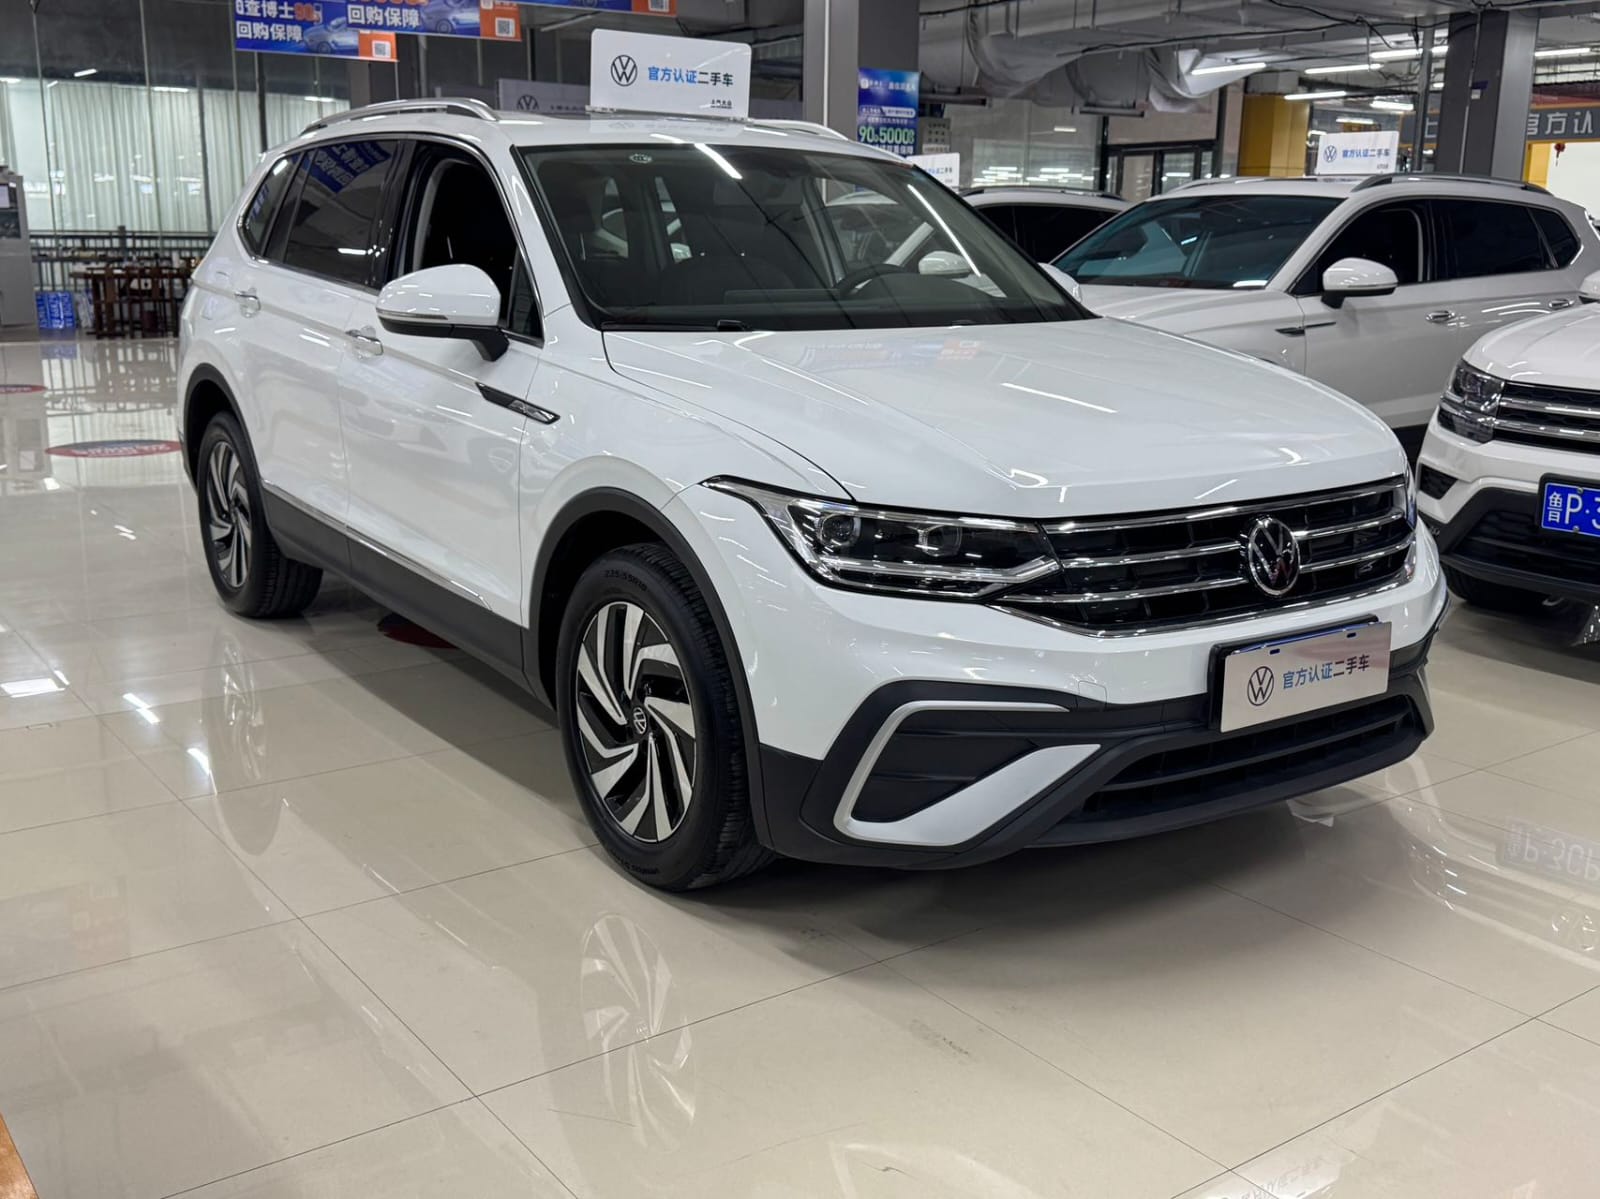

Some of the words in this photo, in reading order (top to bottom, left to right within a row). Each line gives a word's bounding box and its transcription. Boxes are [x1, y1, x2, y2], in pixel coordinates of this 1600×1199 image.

[347, 4, 420, 28] 回购保障
[236, 20, 302, 42] 回购保障
[647, 66, 734, 87] 官方认证二手车
[1282, 654, 1371, 690] 官方认证二手车
